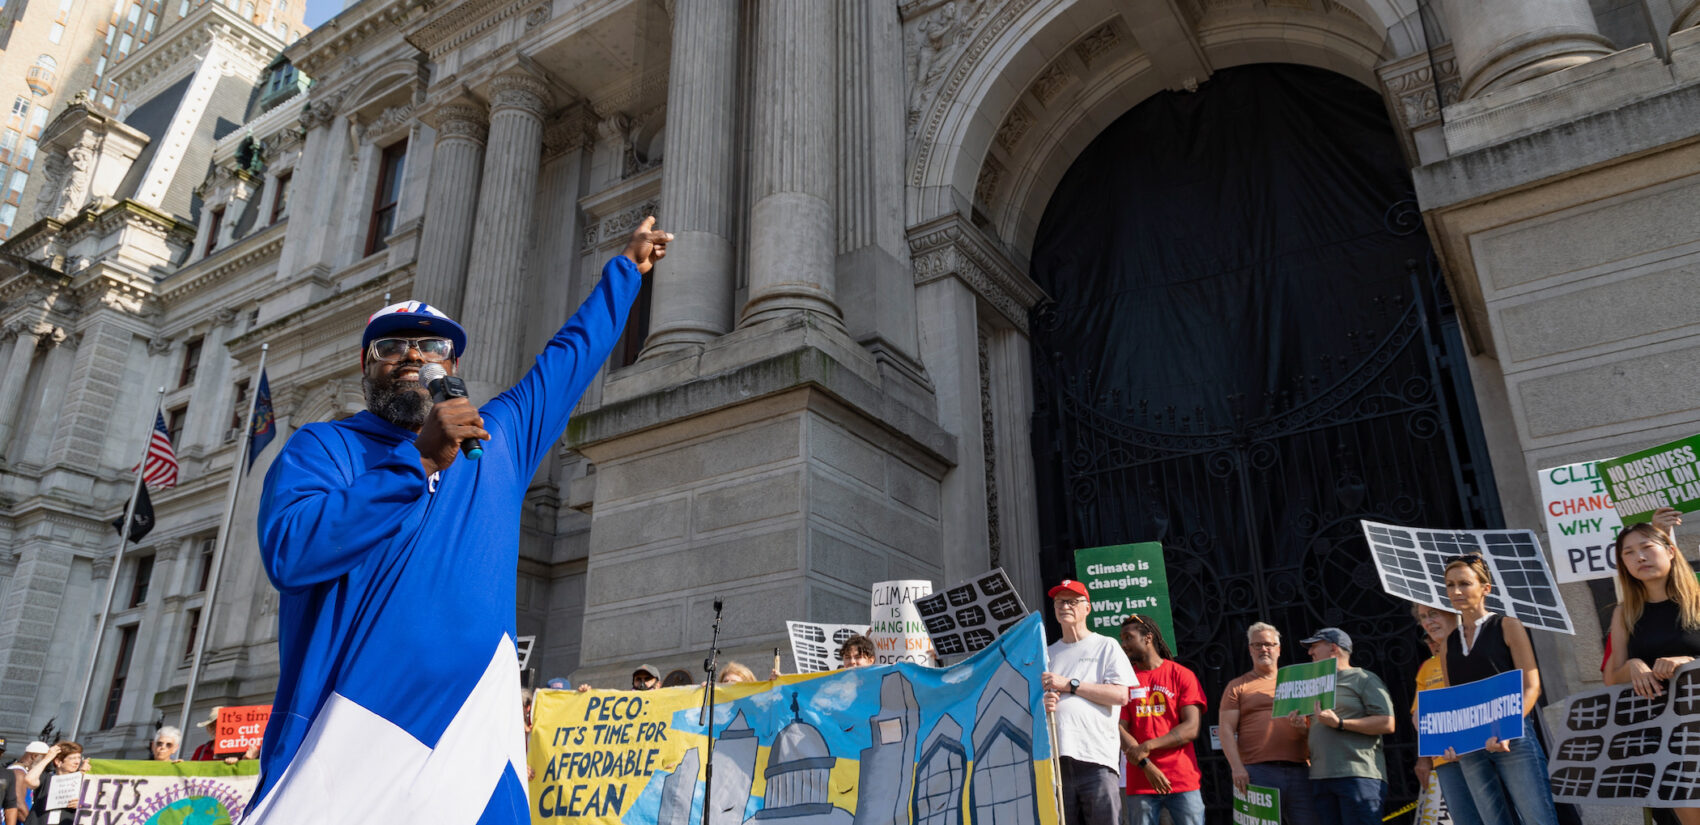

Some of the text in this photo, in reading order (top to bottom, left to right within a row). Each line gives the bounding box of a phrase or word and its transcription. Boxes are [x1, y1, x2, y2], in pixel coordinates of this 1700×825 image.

[1606, 465, 1627, 483] NO
[1623, 445, 1697, 479] BUSINESS
[1612, 482, 1631, 501] AS
[1627, 471, 1674, 497] USUAL
[1671, 463, 1696, 485] ON
[1548, 494, 1616, 517] CHANG
[1614, 490, 1670, 518] BURNING
[1558, 517, 1603, 536] WHY
[1086, 559, 1149, 575] Climate is
[1567, 543, 1617, 573] PEC
[1088, 575, 1152, 590] changing.
[873, 586, 929, 607] CLIMATE
[1091, 596, 1158, 613] Why isn't
[891, 607, 901, 618] IS
[871, 620, 927, 633] HANGING
[875, 637, 897, 651] WHY
[1275, 674, 1335, 701] #PEOPLESENERGYPLAN
[222, 710, 269, 723] It's tim
[584, 696, 649, 721] PECO:
[1420, 692, 1522, 735] #ENVIRONMENTALJUSTICE
[221, 723, 260, 736] to cut
[552, 721, 667, 746] IT'S TIME FOR
[542, 748, 660, 783] AFFORDABLE
[78, 778, 149, 811] LET'S
[538, 783, 628, 819] CLEAN
[1247, 790, 1273, 808] FUELS
